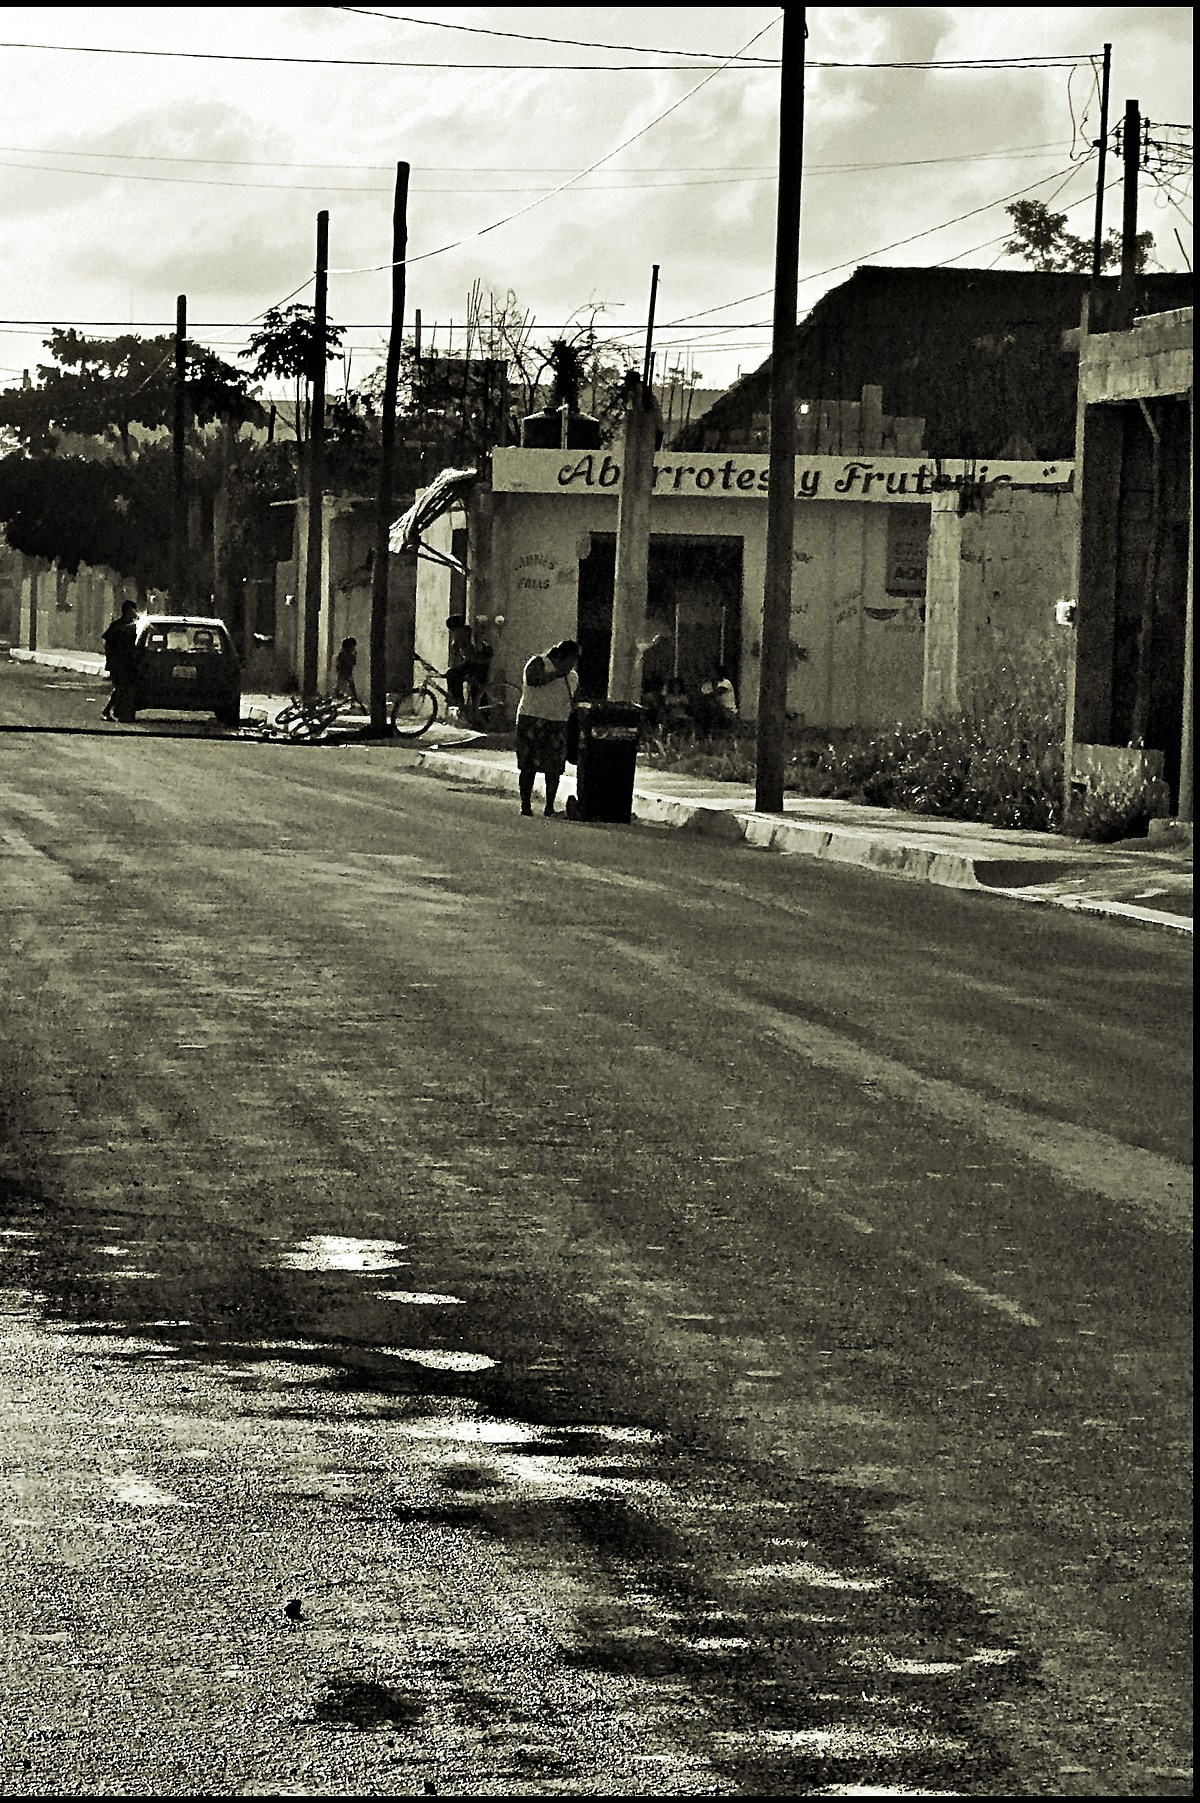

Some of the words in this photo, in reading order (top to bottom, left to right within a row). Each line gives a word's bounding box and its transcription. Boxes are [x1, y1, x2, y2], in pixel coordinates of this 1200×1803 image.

[558, 454, 769, 491] Abrrotes
[797, 470, 820, 497] y
[834, 462, 1012, 495] Fruti
